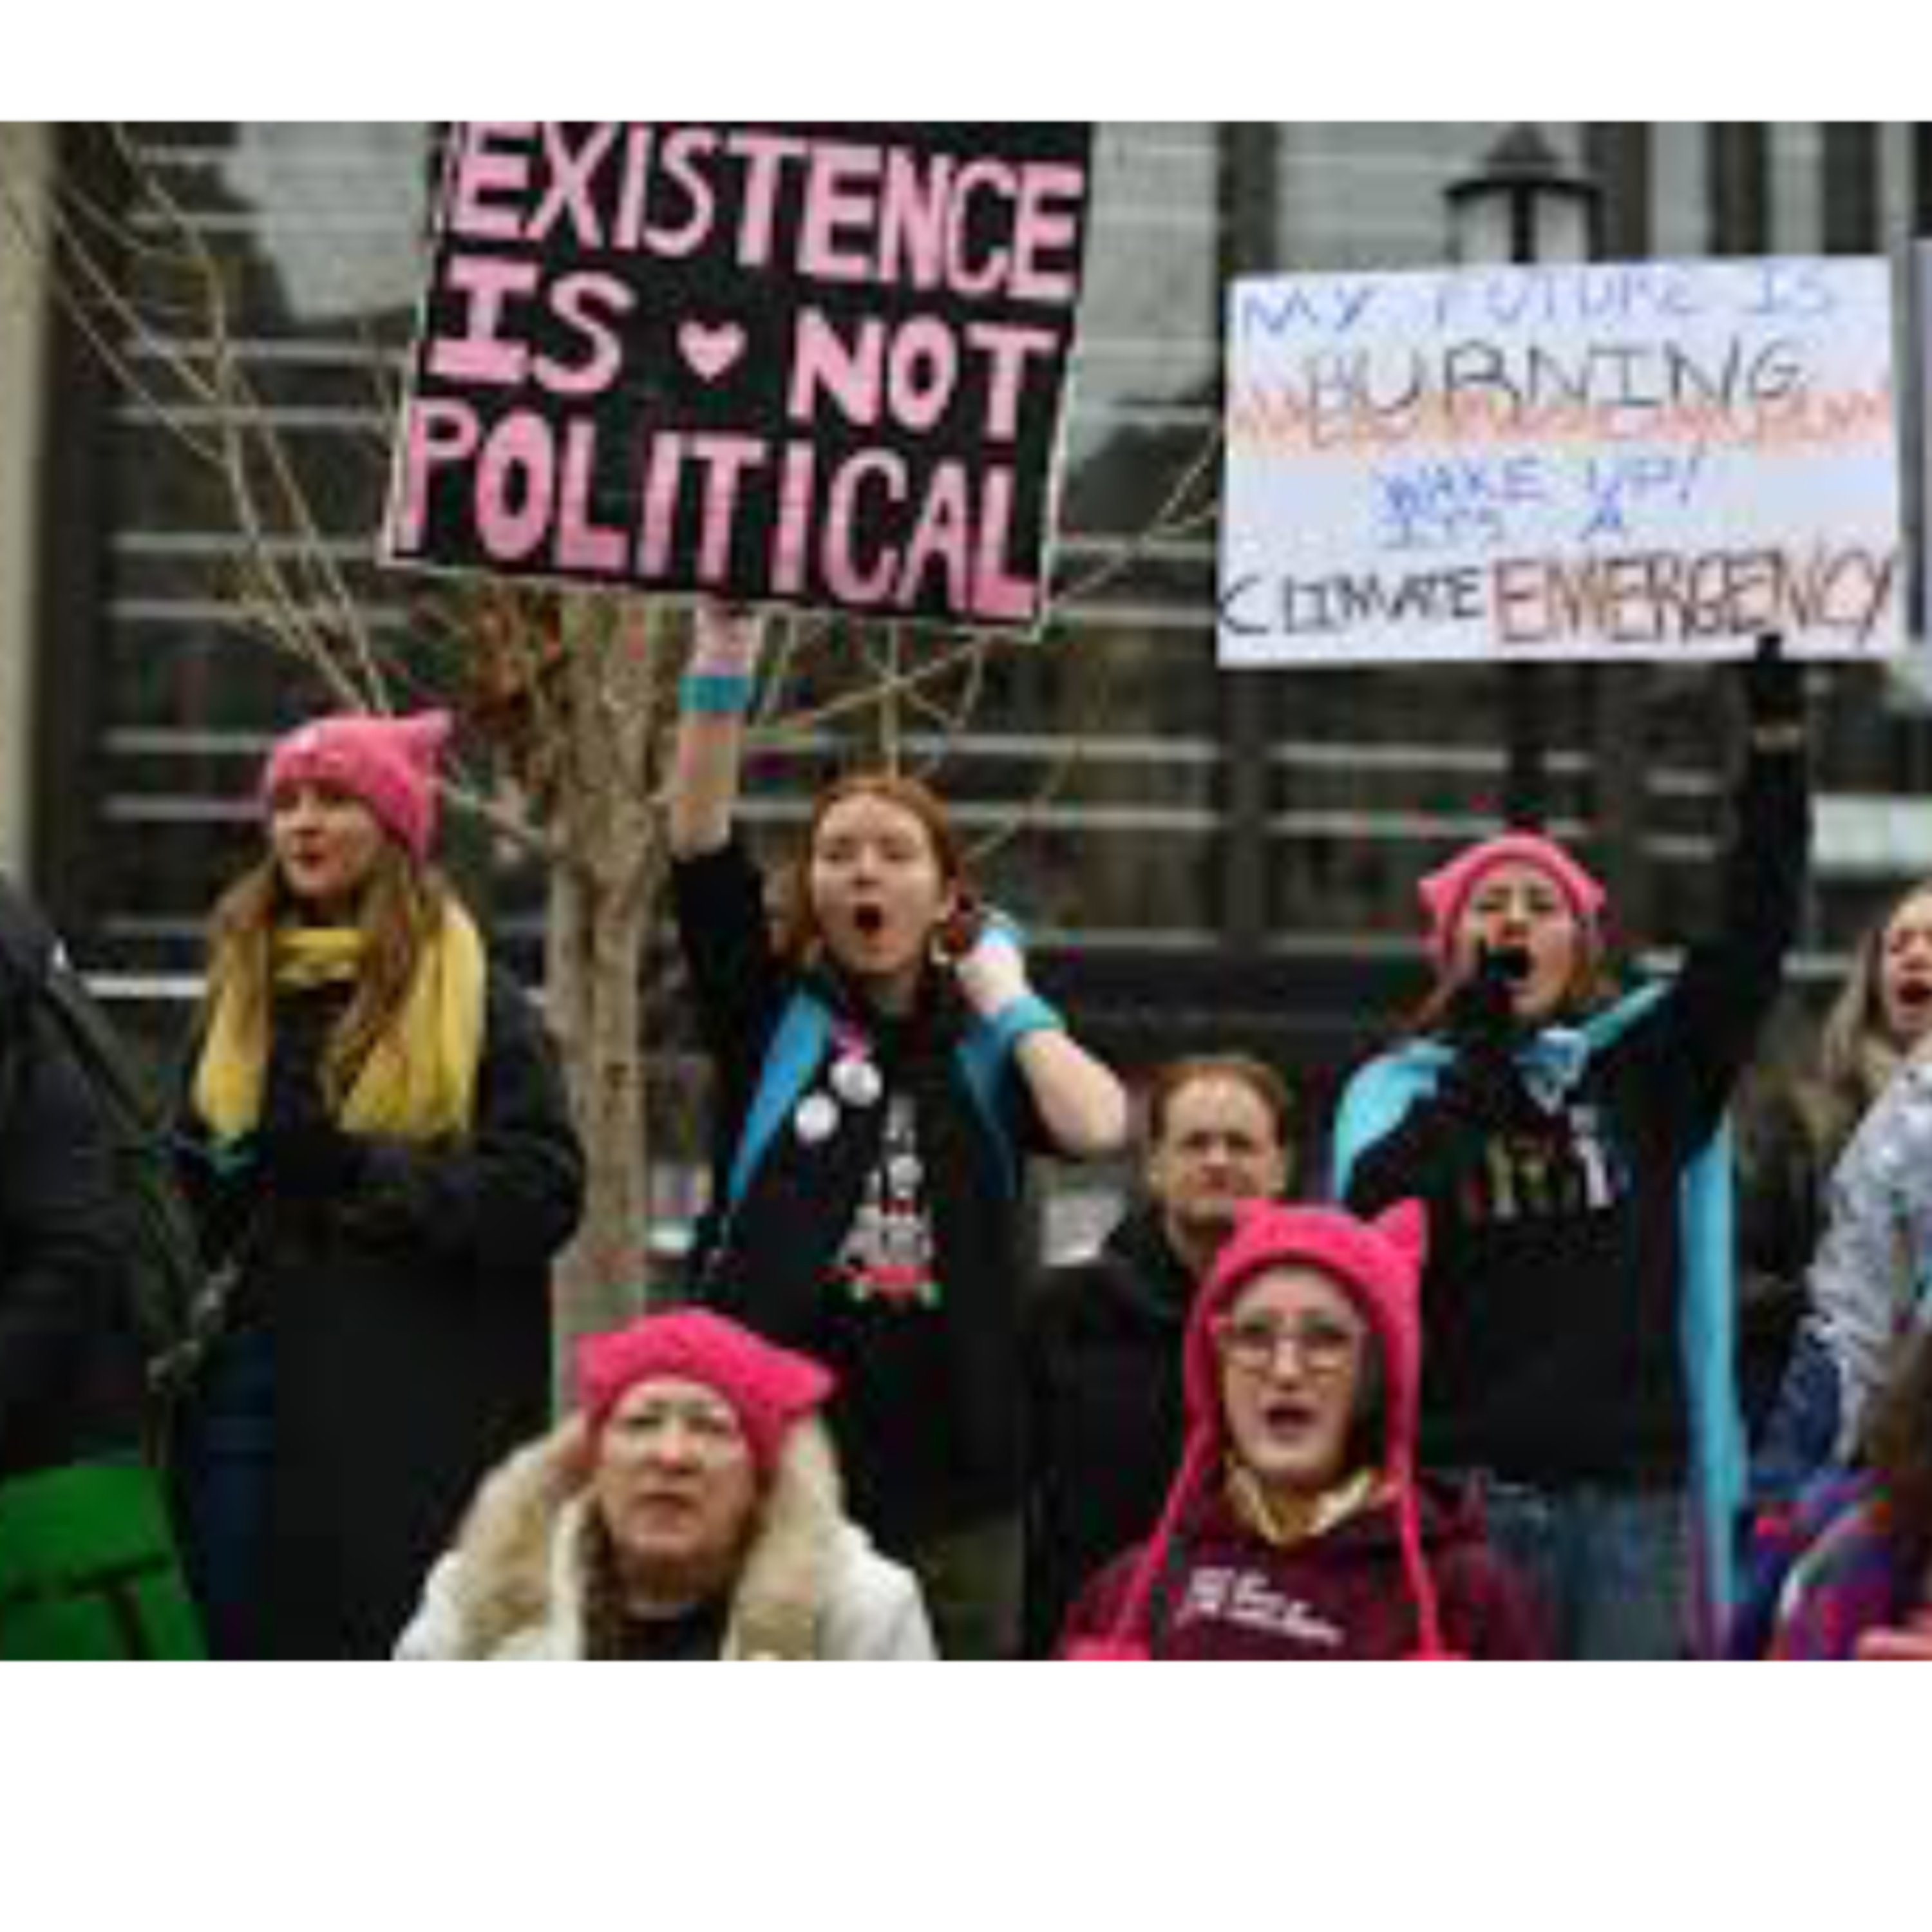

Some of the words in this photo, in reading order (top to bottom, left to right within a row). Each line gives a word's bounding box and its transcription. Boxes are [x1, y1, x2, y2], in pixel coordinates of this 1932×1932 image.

[444, 121, 1085, 301] EXISTENCE
[425, 254, 638, 394] IS
[787, 308, 1057, 440] NOT
[1304, 335, 1803, 447] BURNING
[394, 399, 1038, 618] POLITICAL
[1494, 549, 1892, 645] EMERGENCY
